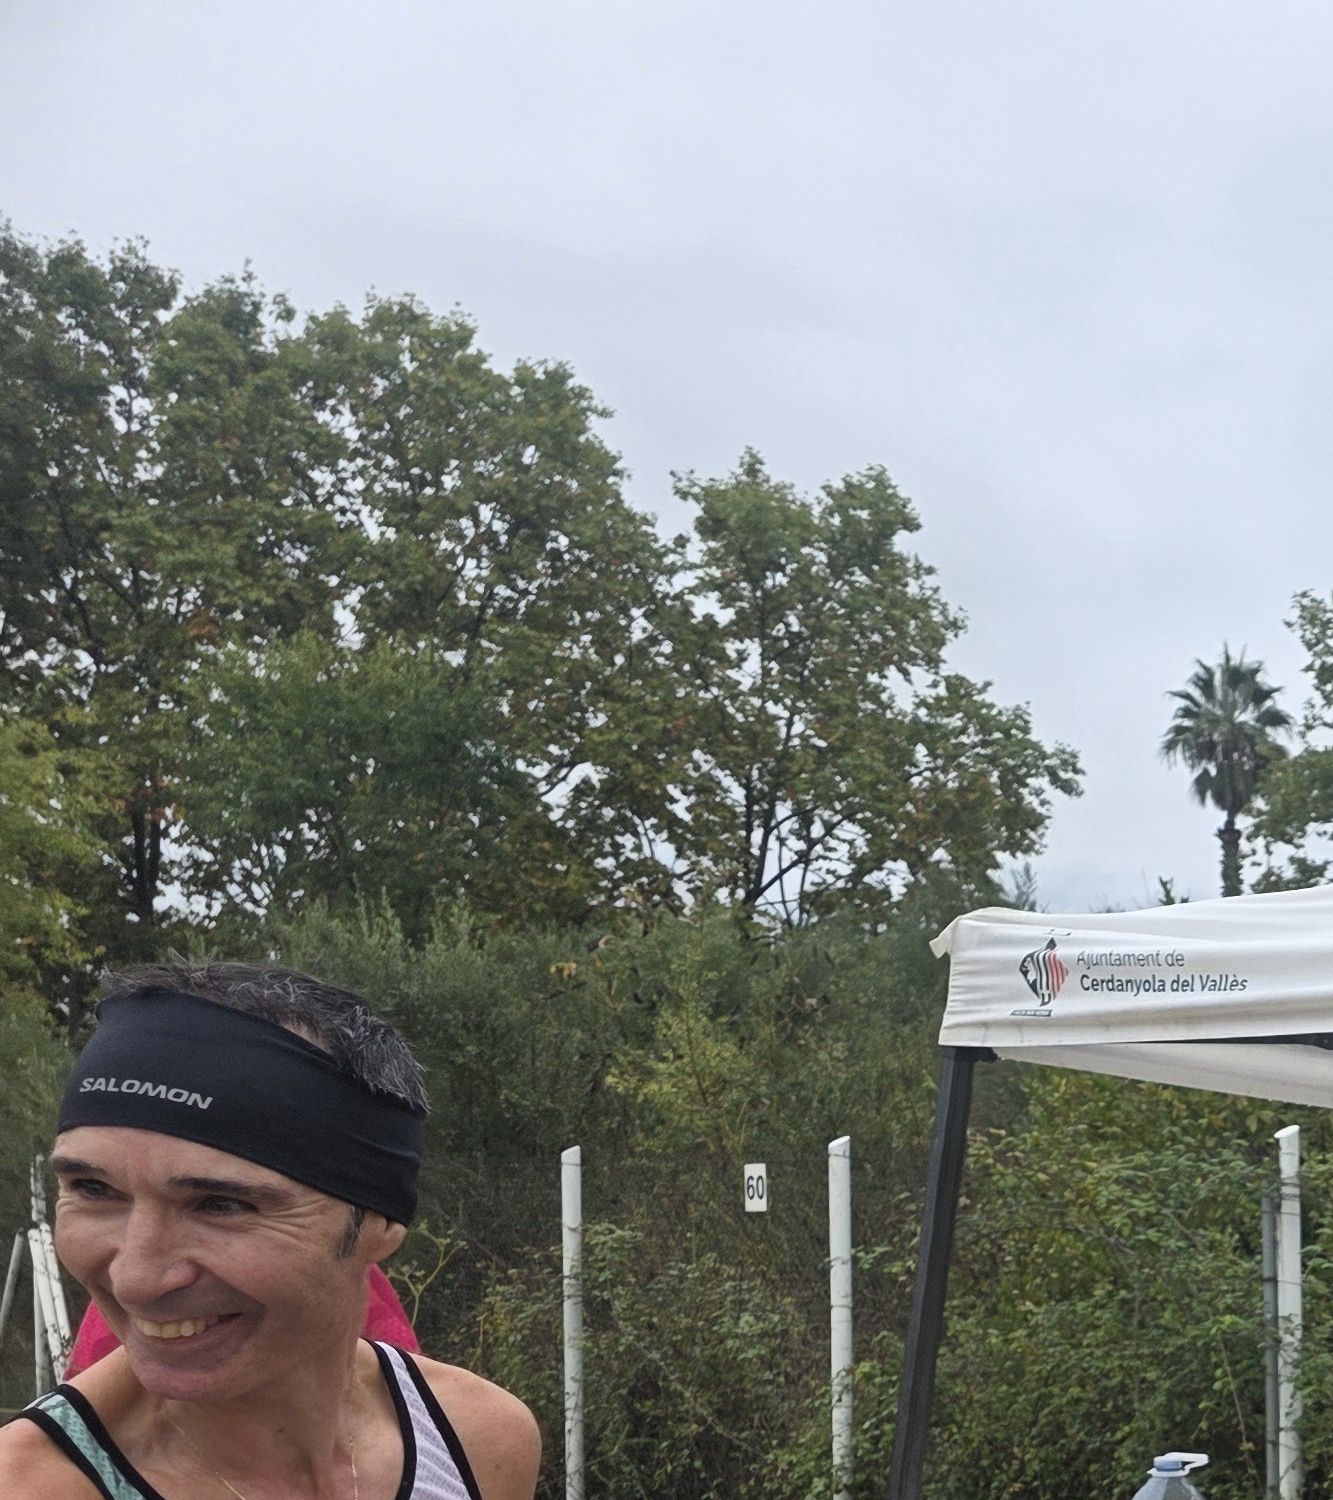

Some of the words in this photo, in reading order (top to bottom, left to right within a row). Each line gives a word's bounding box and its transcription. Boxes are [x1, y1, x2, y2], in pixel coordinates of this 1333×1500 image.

[1077, 950, 1161, 970] Ajuntament
[1164, 950, 1184, 967] de
[1080, 974, 1166, 996] Cerdanyola
[1171, 974, 1194, 992] del
[1199, 974, 1248, 991] Vallès
[80, 1077, 213, 1109] SALOMON
[747, 1175, 764, 1200] 60
